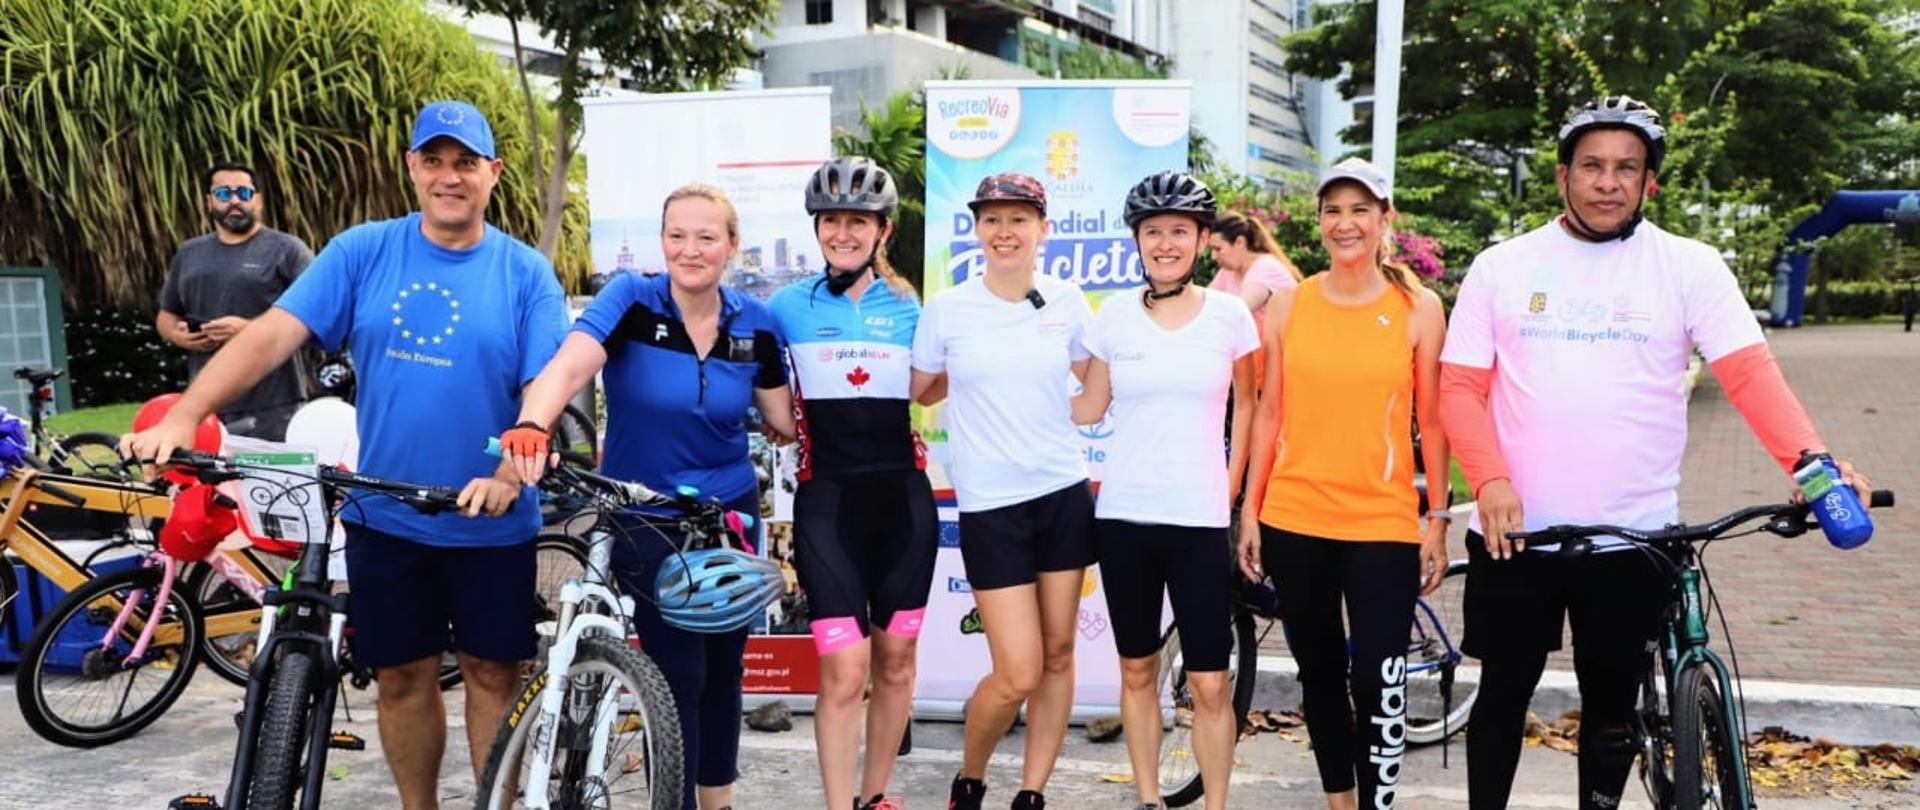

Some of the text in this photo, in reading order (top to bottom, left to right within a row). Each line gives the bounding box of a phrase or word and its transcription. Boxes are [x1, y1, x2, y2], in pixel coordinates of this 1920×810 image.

[1049, 210, 1105, 233] ndial
[1519, 326, 1650, 343] #WorldBicycleDay
[508, 671, 548, 729] MAXXI
[1369, 655, 1406, 810] adidas
